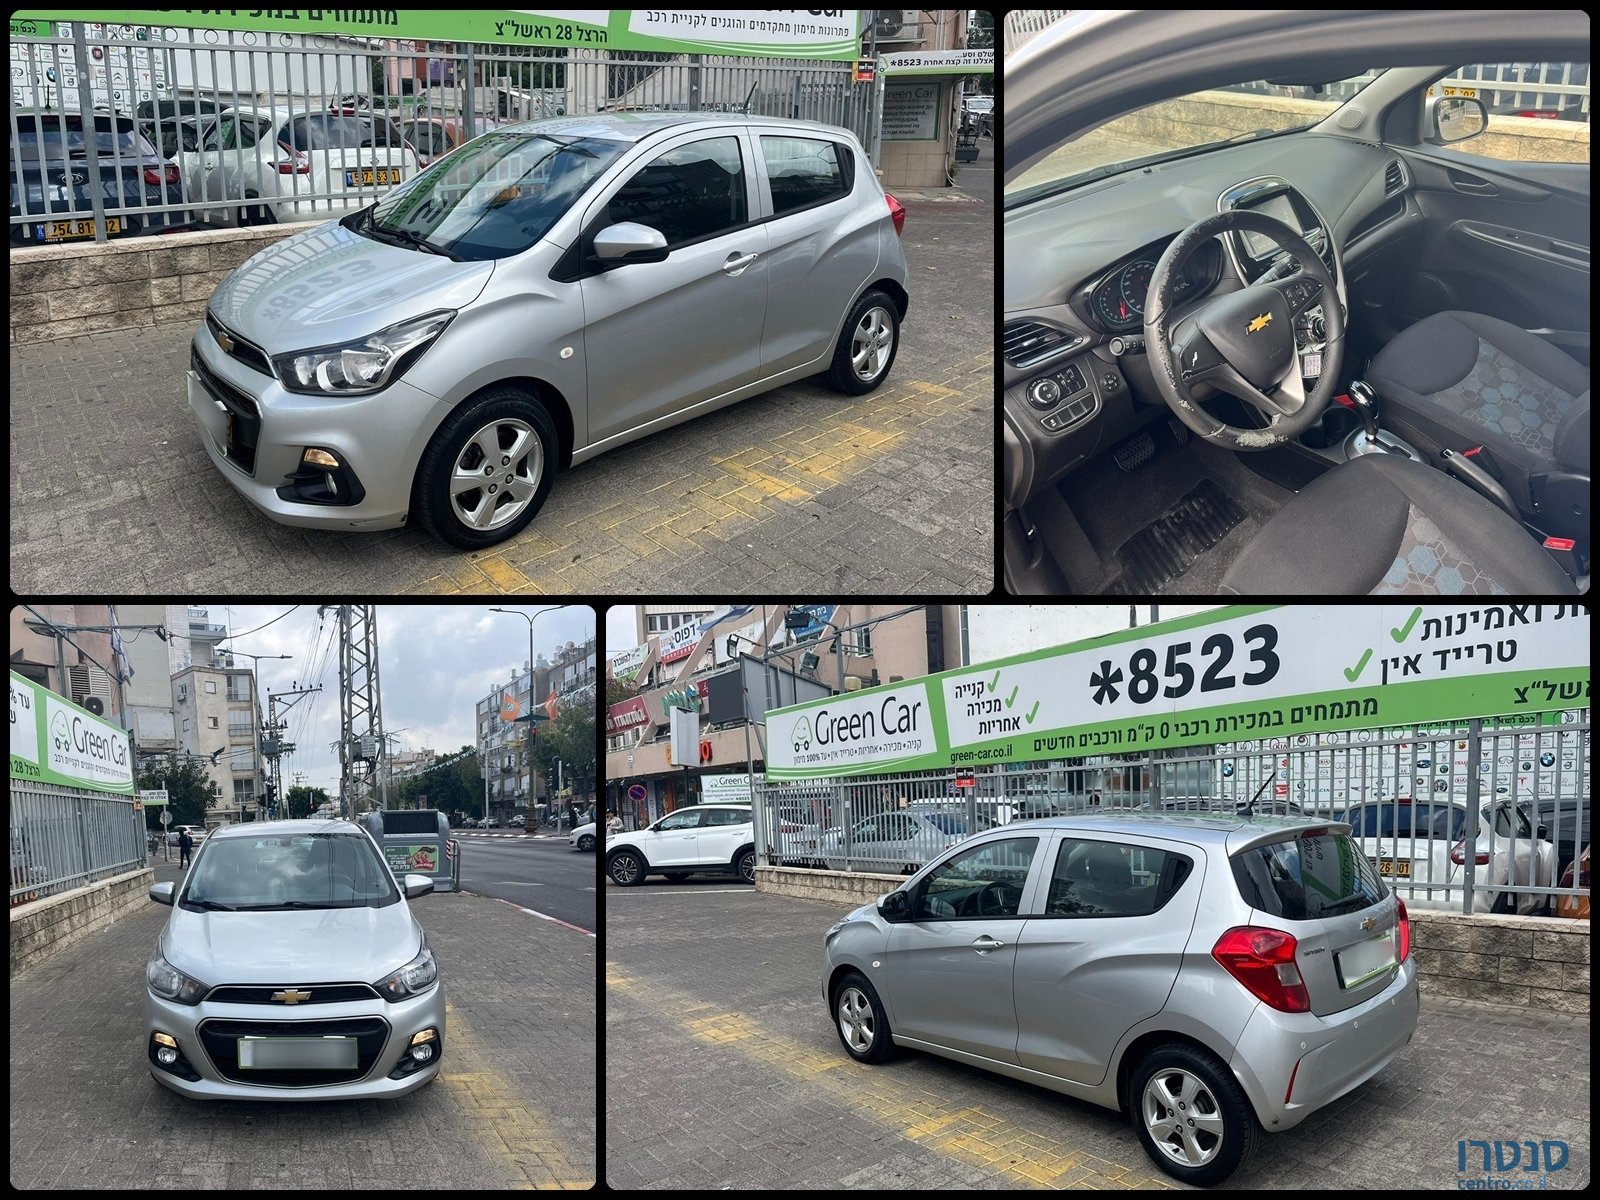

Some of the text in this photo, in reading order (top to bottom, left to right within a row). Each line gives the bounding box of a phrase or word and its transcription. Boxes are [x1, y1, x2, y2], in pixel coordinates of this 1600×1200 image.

[556, 24, 573, 41] 28
[646, 11, 849, 37] פתרונות מימון מתקדמים והוגנים לקניית רכב
[576, 26, 608, 43] הרצל
[915, 88, 934, 98] Car
[1421, 605, 1542, 641] ואמינות
[674, 624, 696, 644] דפוס
[1381, 639, 1518, 685] טרייד אין
[955, 680, 985, 699] קנייה
[18, 692, 30, 709] עד
[967, 698, 1002, 717] מכירה
[1291, 697, 1378, 724] מתמחים
[815, 696, 922, 746] Green Car
[978, 716, 1021, 735] אחריות
[1160, 721, 1170, 739] 0
[1174, 719, 1210, 738] רכבי
[1214, 709, 1284, 733] במכירת
[73, 716, 127, 767] Green Car
[907, 739, 922, 751] קניה
[1034, 735, 1075, 752] חדשים
[1079, 728, 1122, 747] ורכבים
[820, 752, 827, 760] עד
[840, 748, 854, 757] טרייד
[858, 745, 879, 756] אחריות
[883, 742, 902, 753] מכירה
[950, 743, 1013, 765] green-car.co.il
[807, 753, 821, 763] 100%
[15, 761, 23, 774] 28
[25, 765, 41, 777] הרצל
[719, 776, 742, 786] Green
